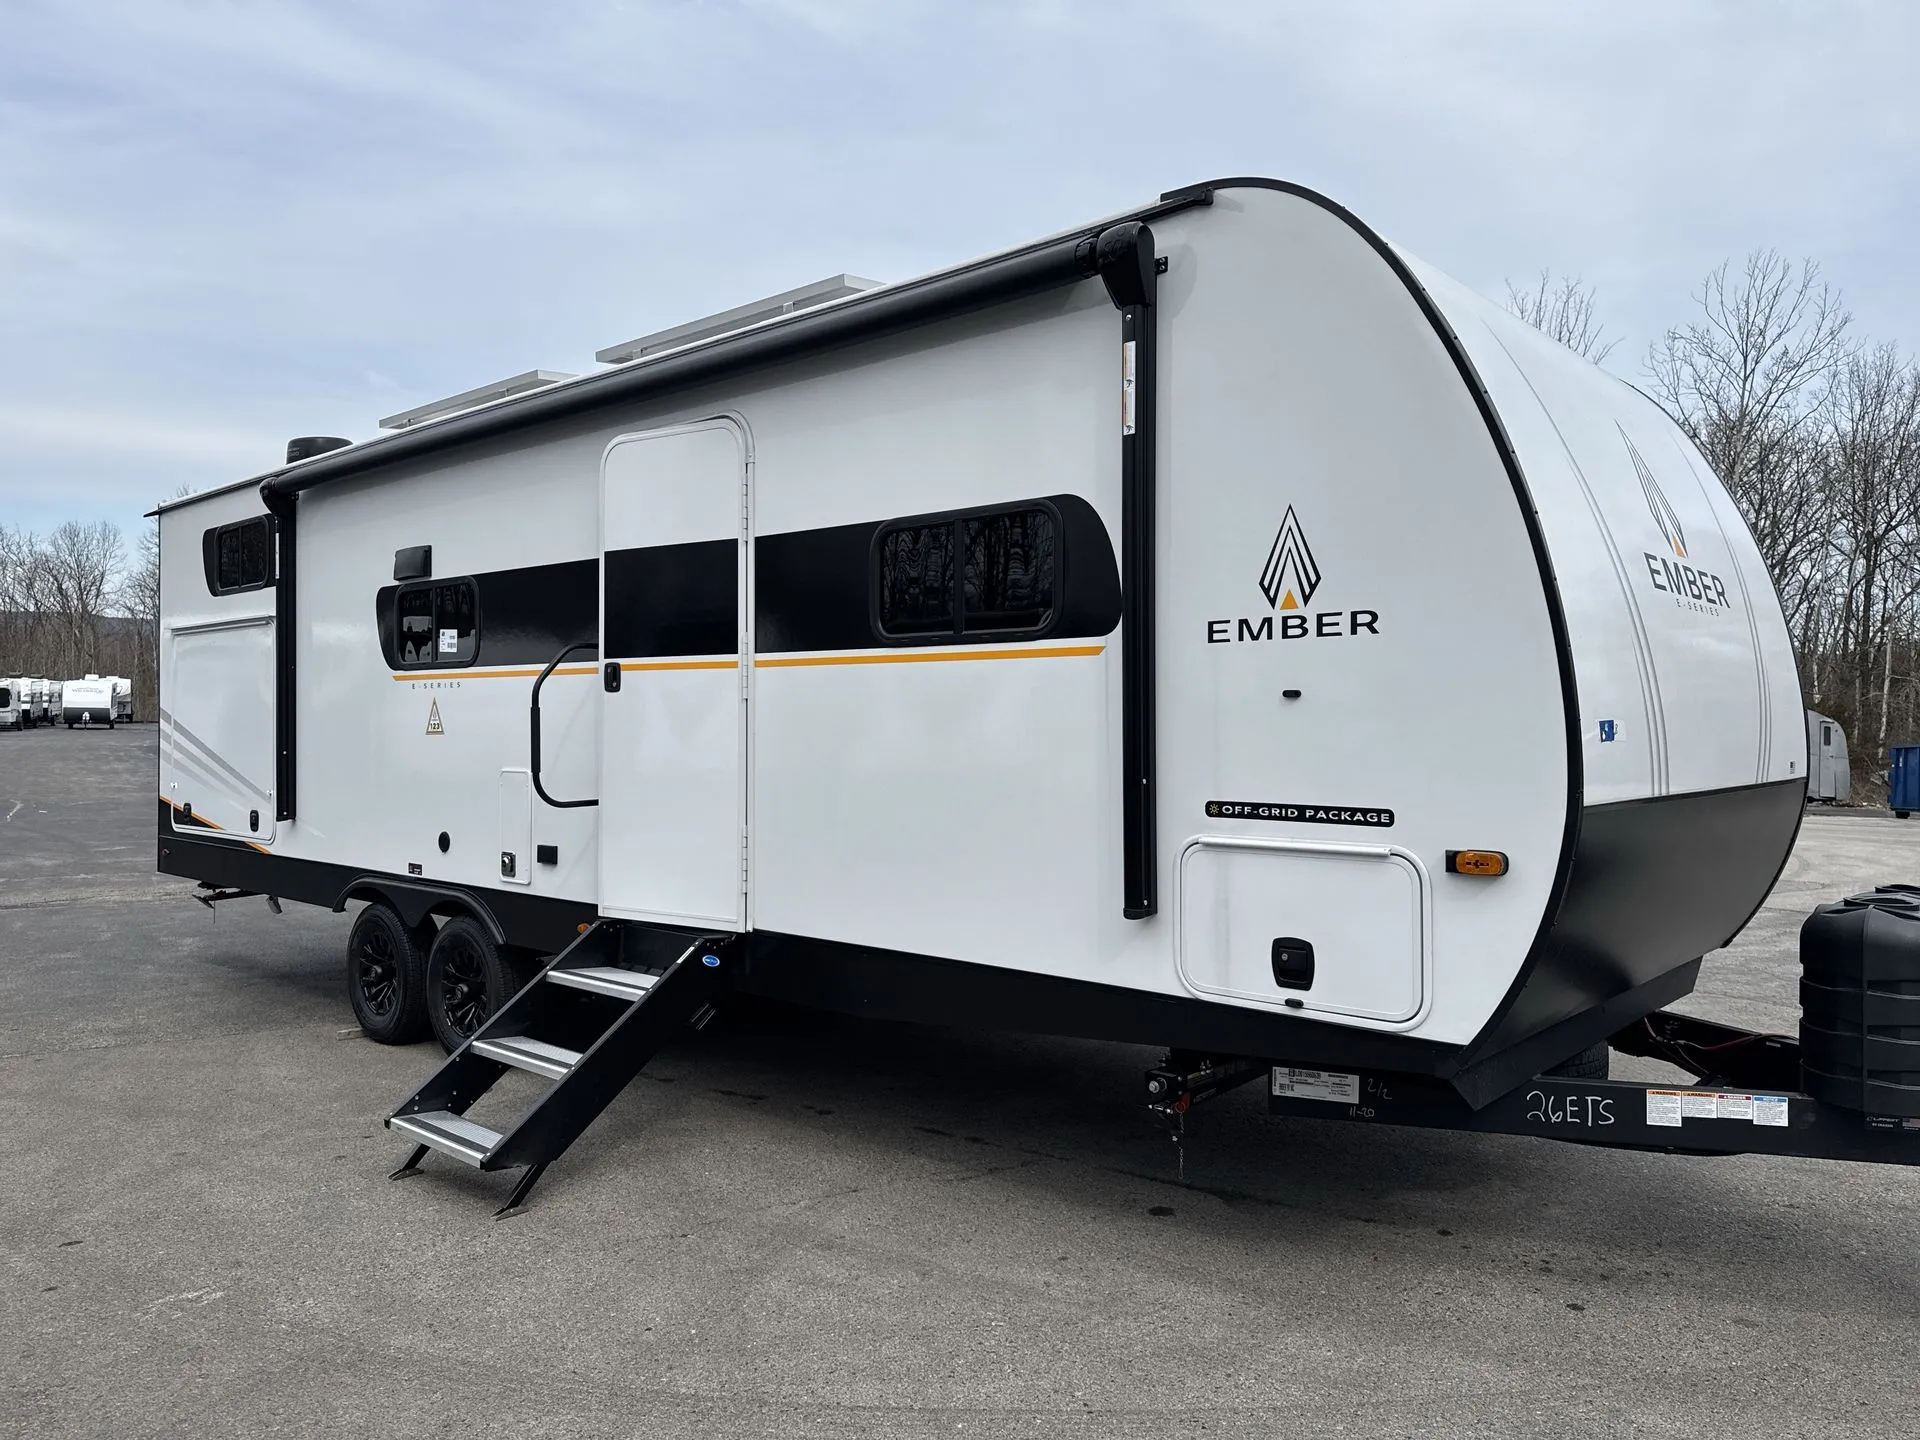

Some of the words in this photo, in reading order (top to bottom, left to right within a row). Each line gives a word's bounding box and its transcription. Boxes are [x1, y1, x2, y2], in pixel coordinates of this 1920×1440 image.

[1643, 552, 1730, 609] EMBER
[1207, 609, 1380, 644] EMBER
[1221, 805, 1299, 818] OFF-GRID
[1305, 809, 1391, 823] PACKAGE
[1526, 1090, 1615, 1127] 26ETS
